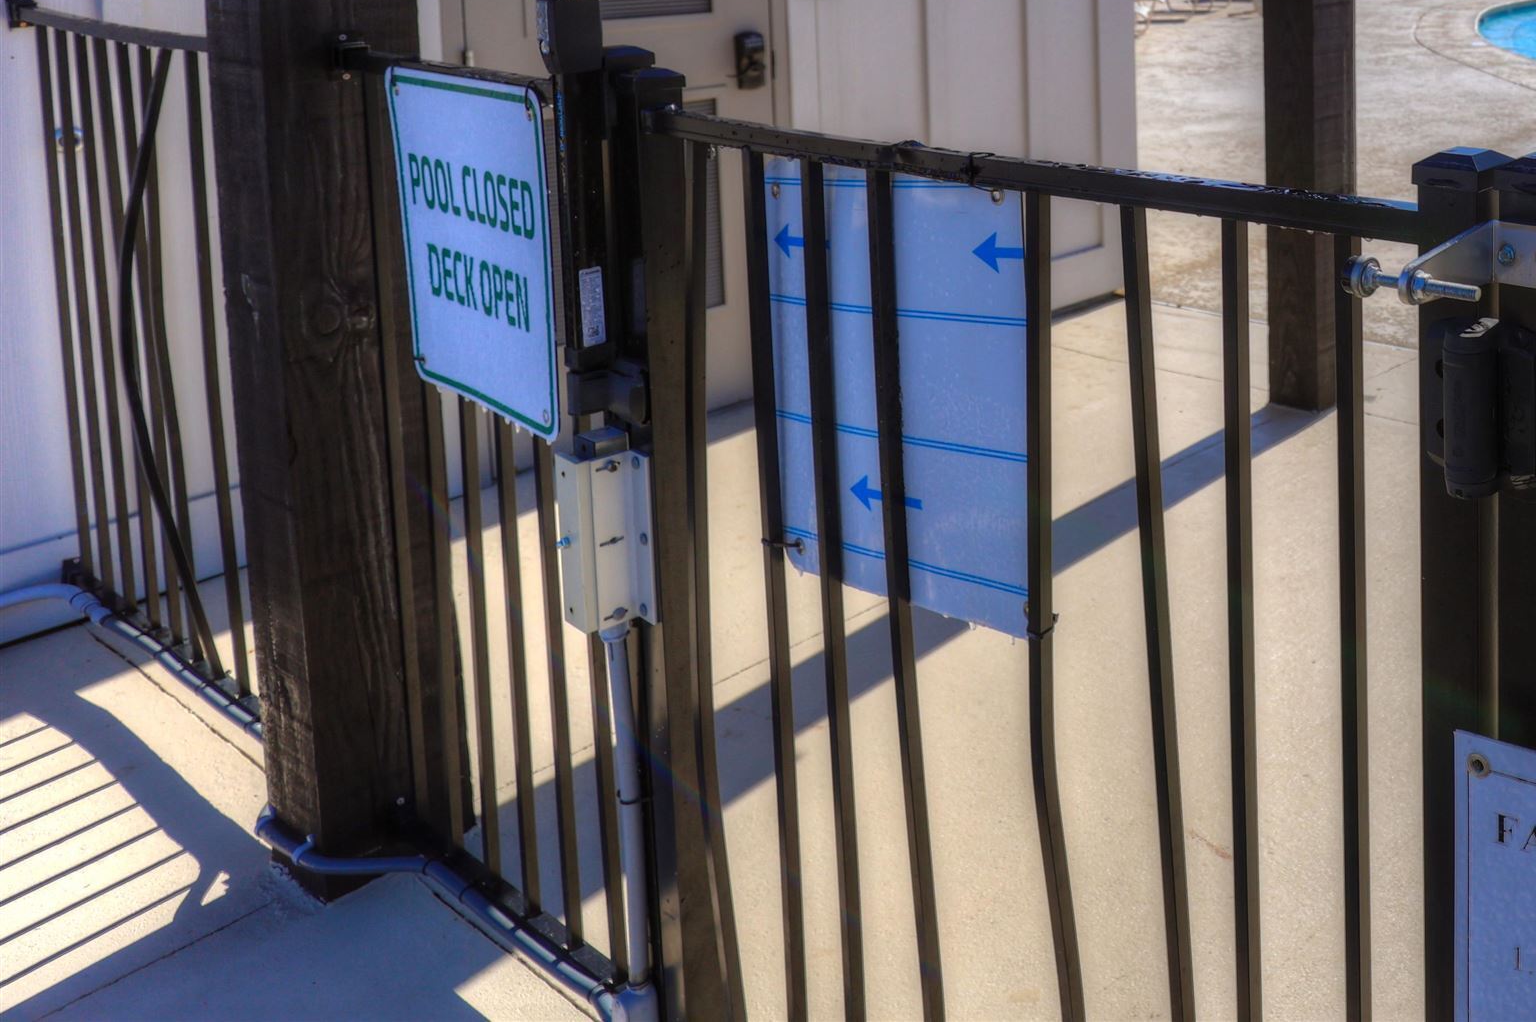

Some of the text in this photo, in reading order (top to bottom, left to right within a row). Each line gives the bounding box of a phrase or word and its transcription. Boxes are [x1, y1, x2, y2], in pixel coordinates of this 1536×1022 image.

[408, 152, 535, 240] POOL CLOSED
[426, 242, 478, 311] DECK
[479, 259, 530, 333] OPEN
[1512, 946, 1534, 975] 1.
